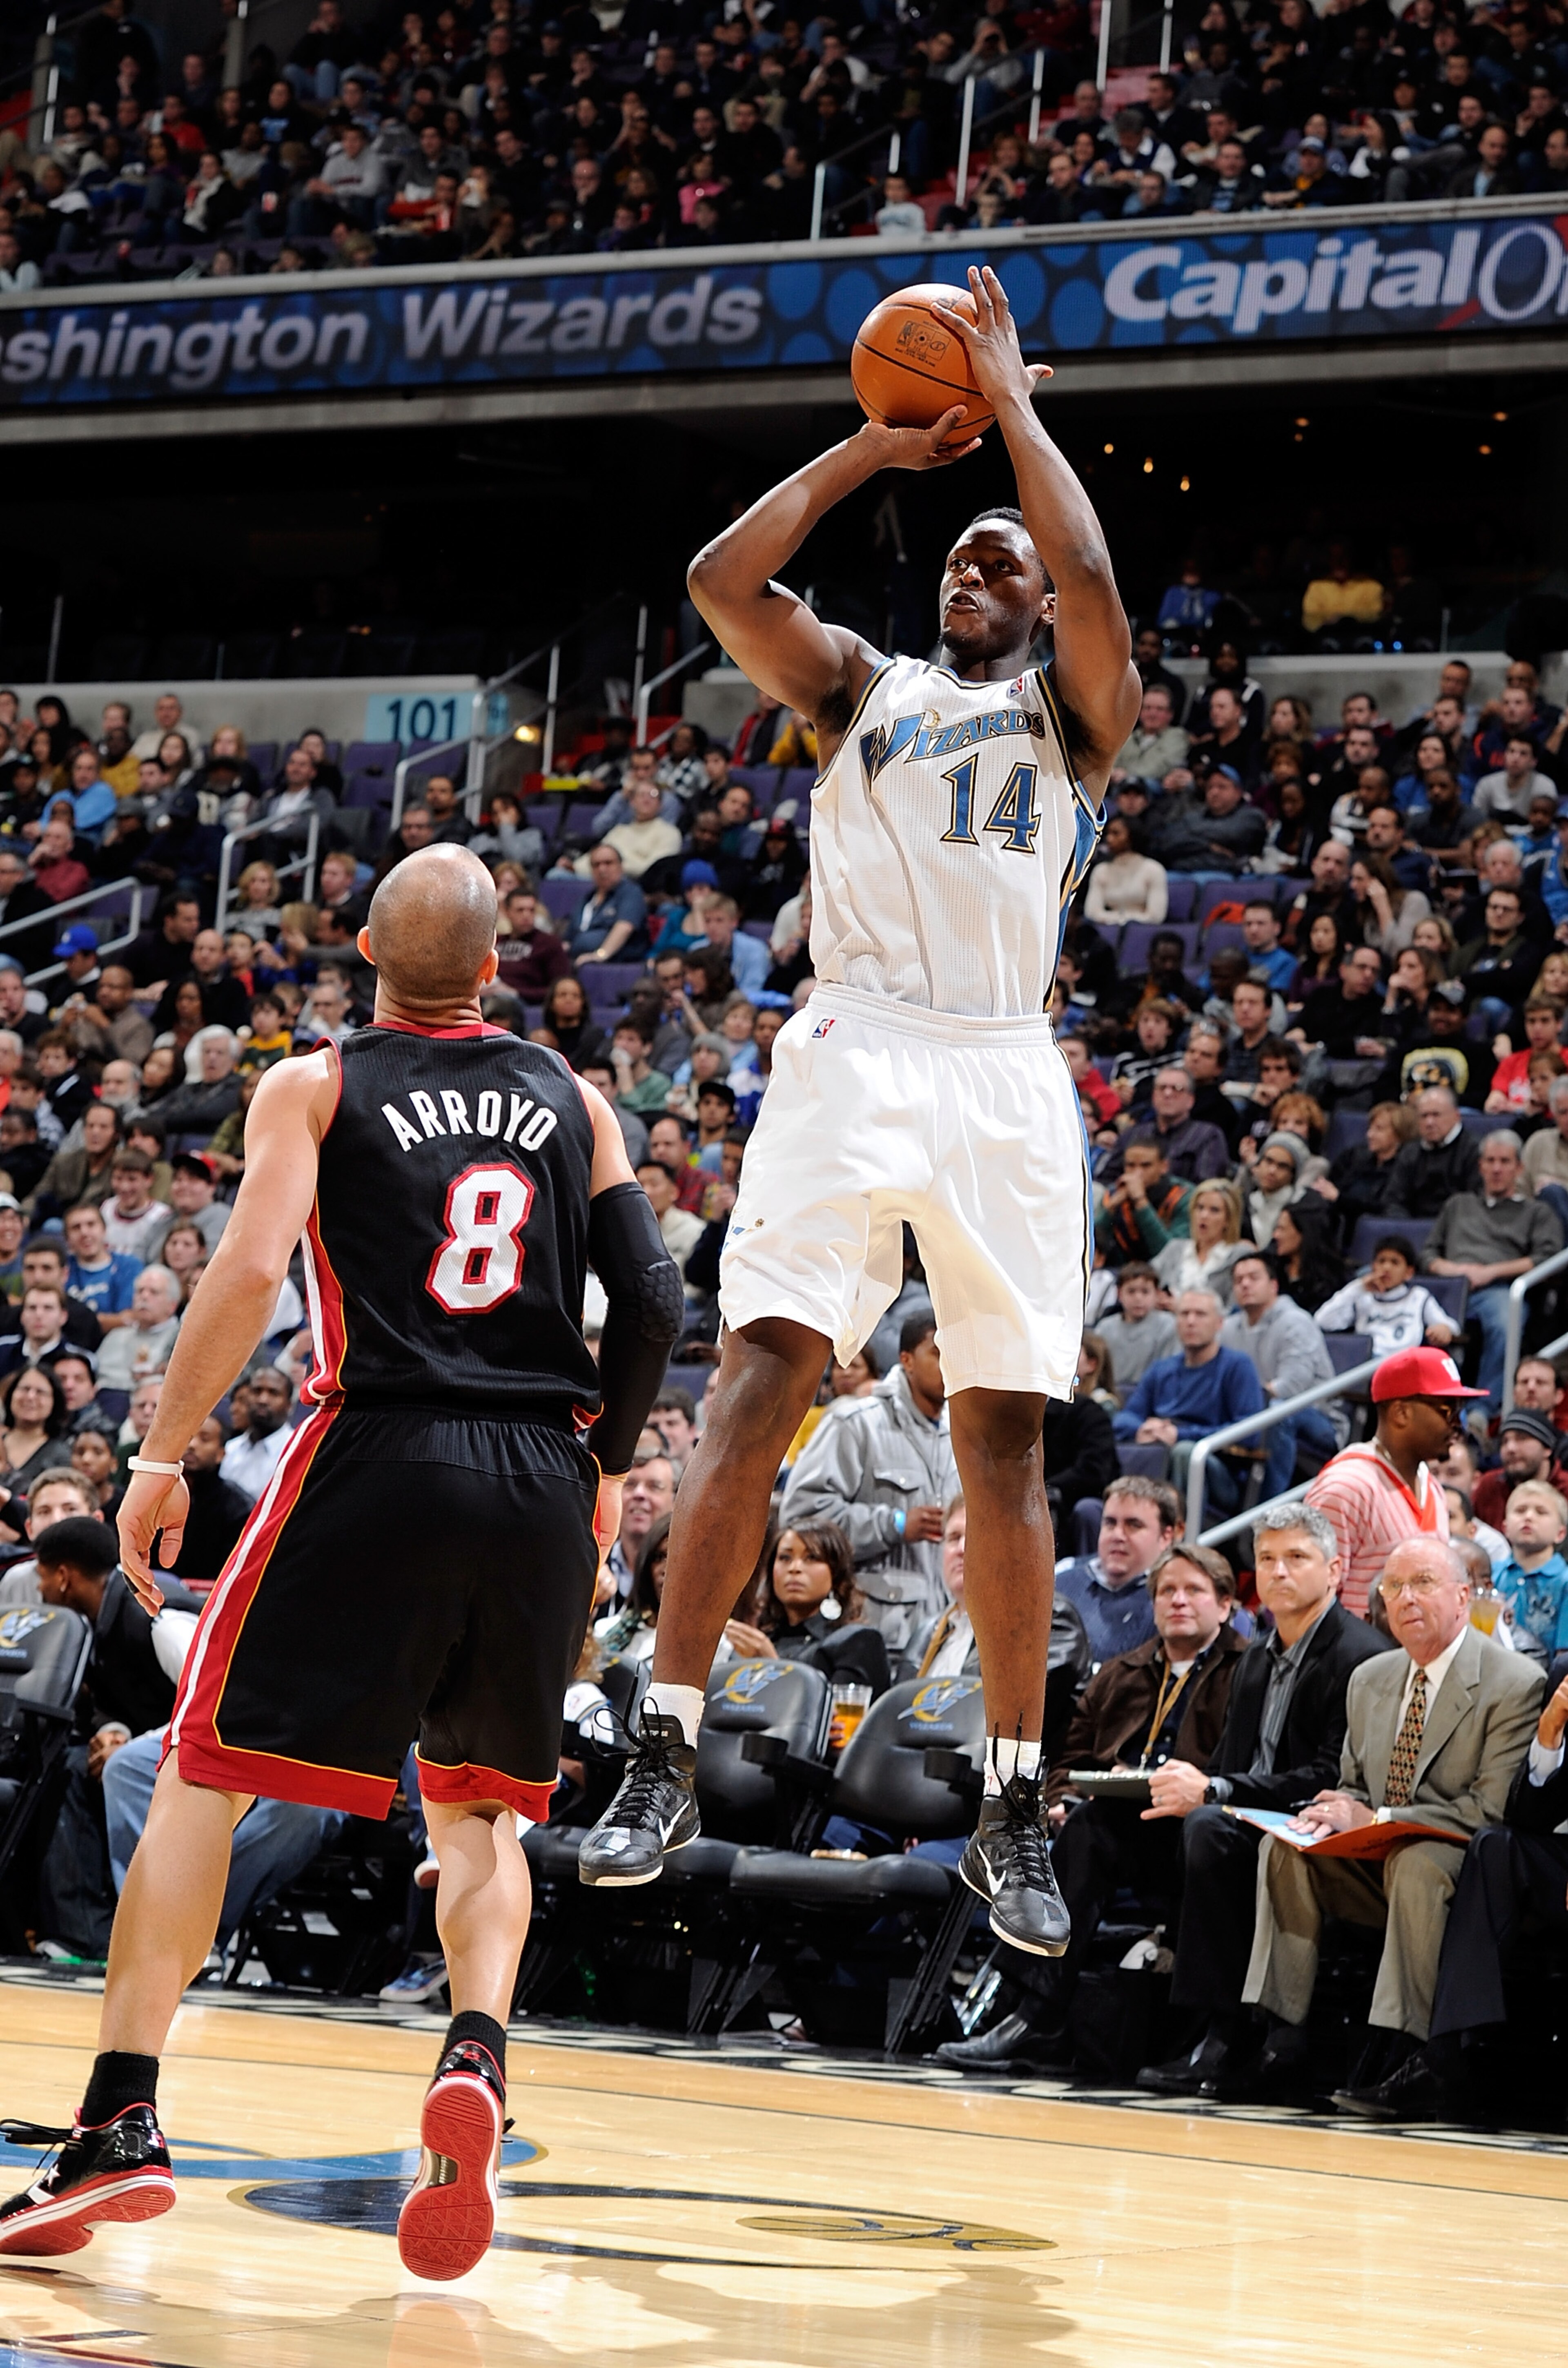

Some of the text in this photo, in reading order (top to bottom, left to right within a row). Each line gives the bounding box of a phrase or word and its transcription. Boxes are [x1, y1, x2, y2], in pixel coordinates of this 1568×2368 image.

[1104, 227, 1481, 334] Capital
[0, 275, 764, 392] shington Wizards
[387, 698, 456, 742] 101
[940, 752, 1042, 854] 14
[381, 1089, 558, 1152] ARROYO
[425, 1162, 535, 1315] 8
